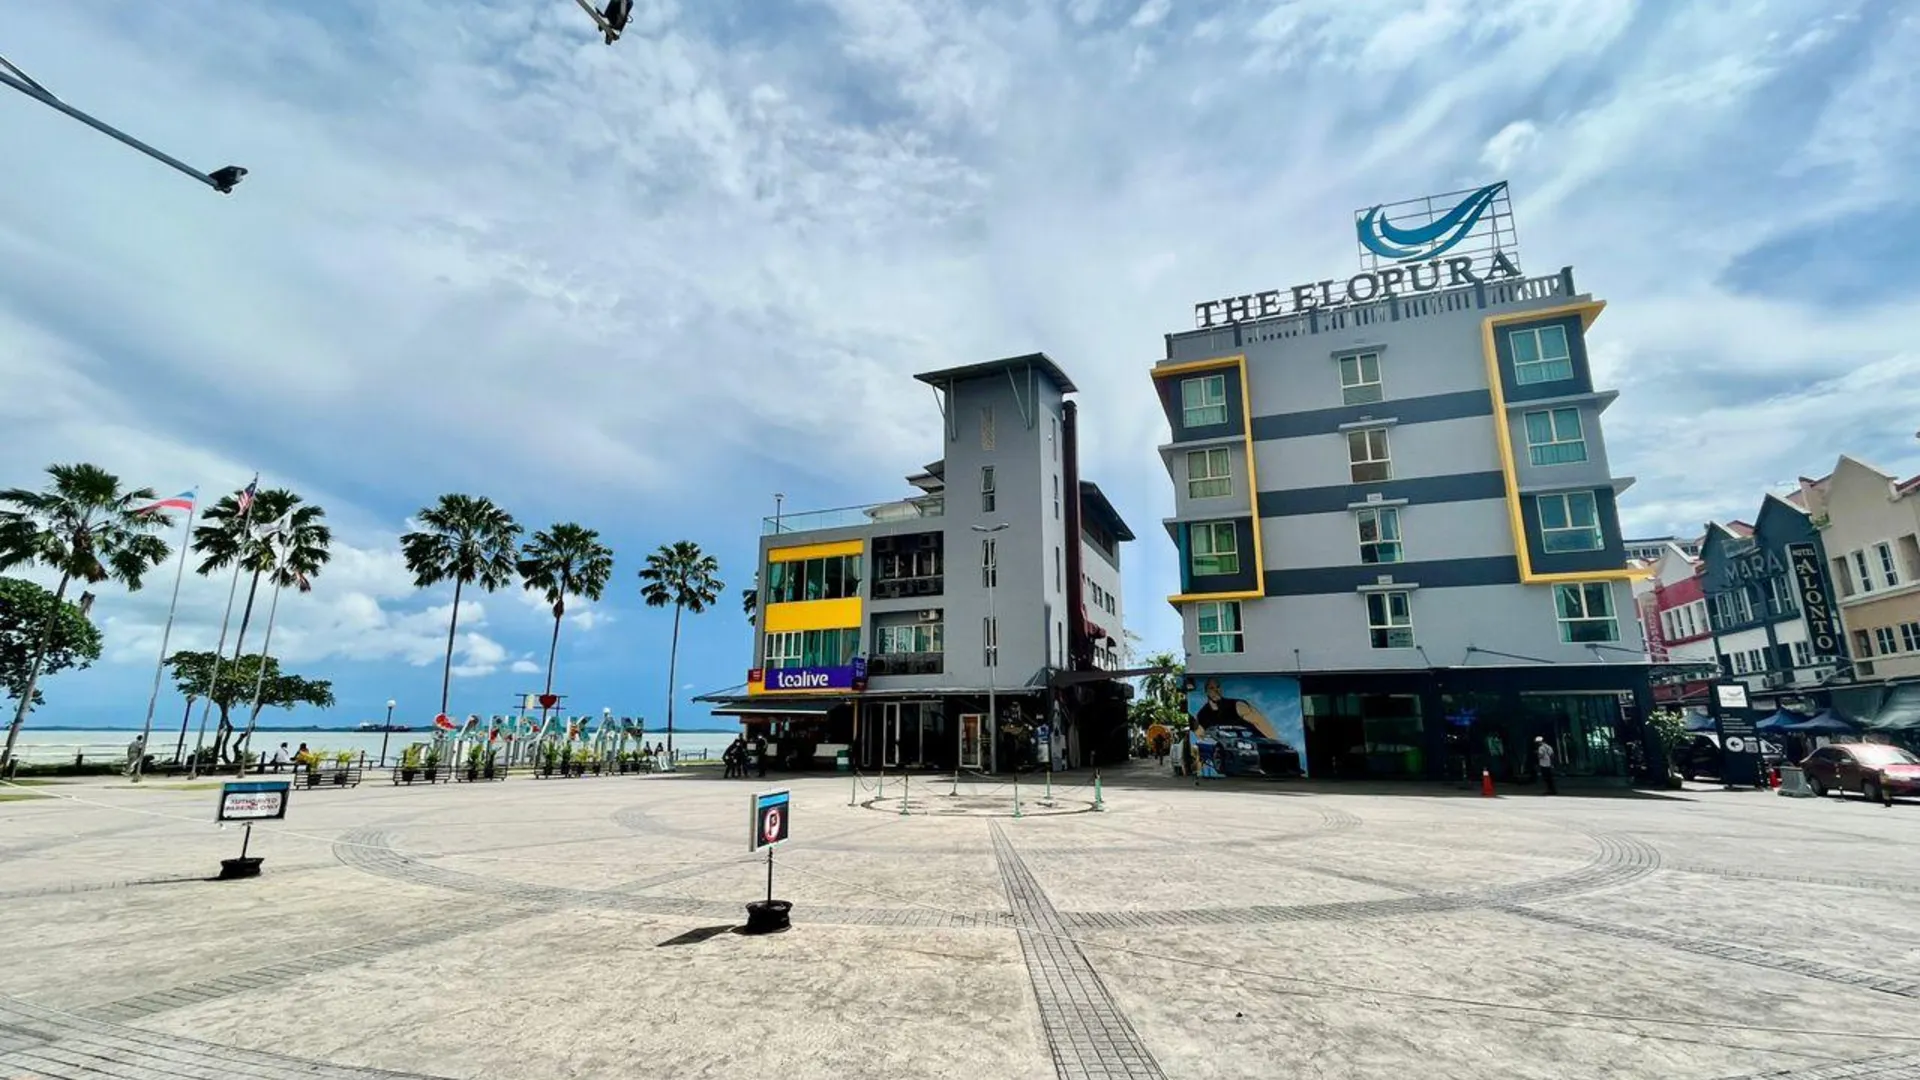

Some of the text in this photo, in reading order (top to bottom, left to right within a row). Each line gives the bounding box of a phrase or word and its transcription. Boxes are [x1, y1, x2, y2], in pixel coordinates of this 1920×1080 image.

[1194, 250, 1521, 328] THE ELOPURA
[1796, 558, 1833, 649] ALONTO
[778, 671, 829, 687] tealive
